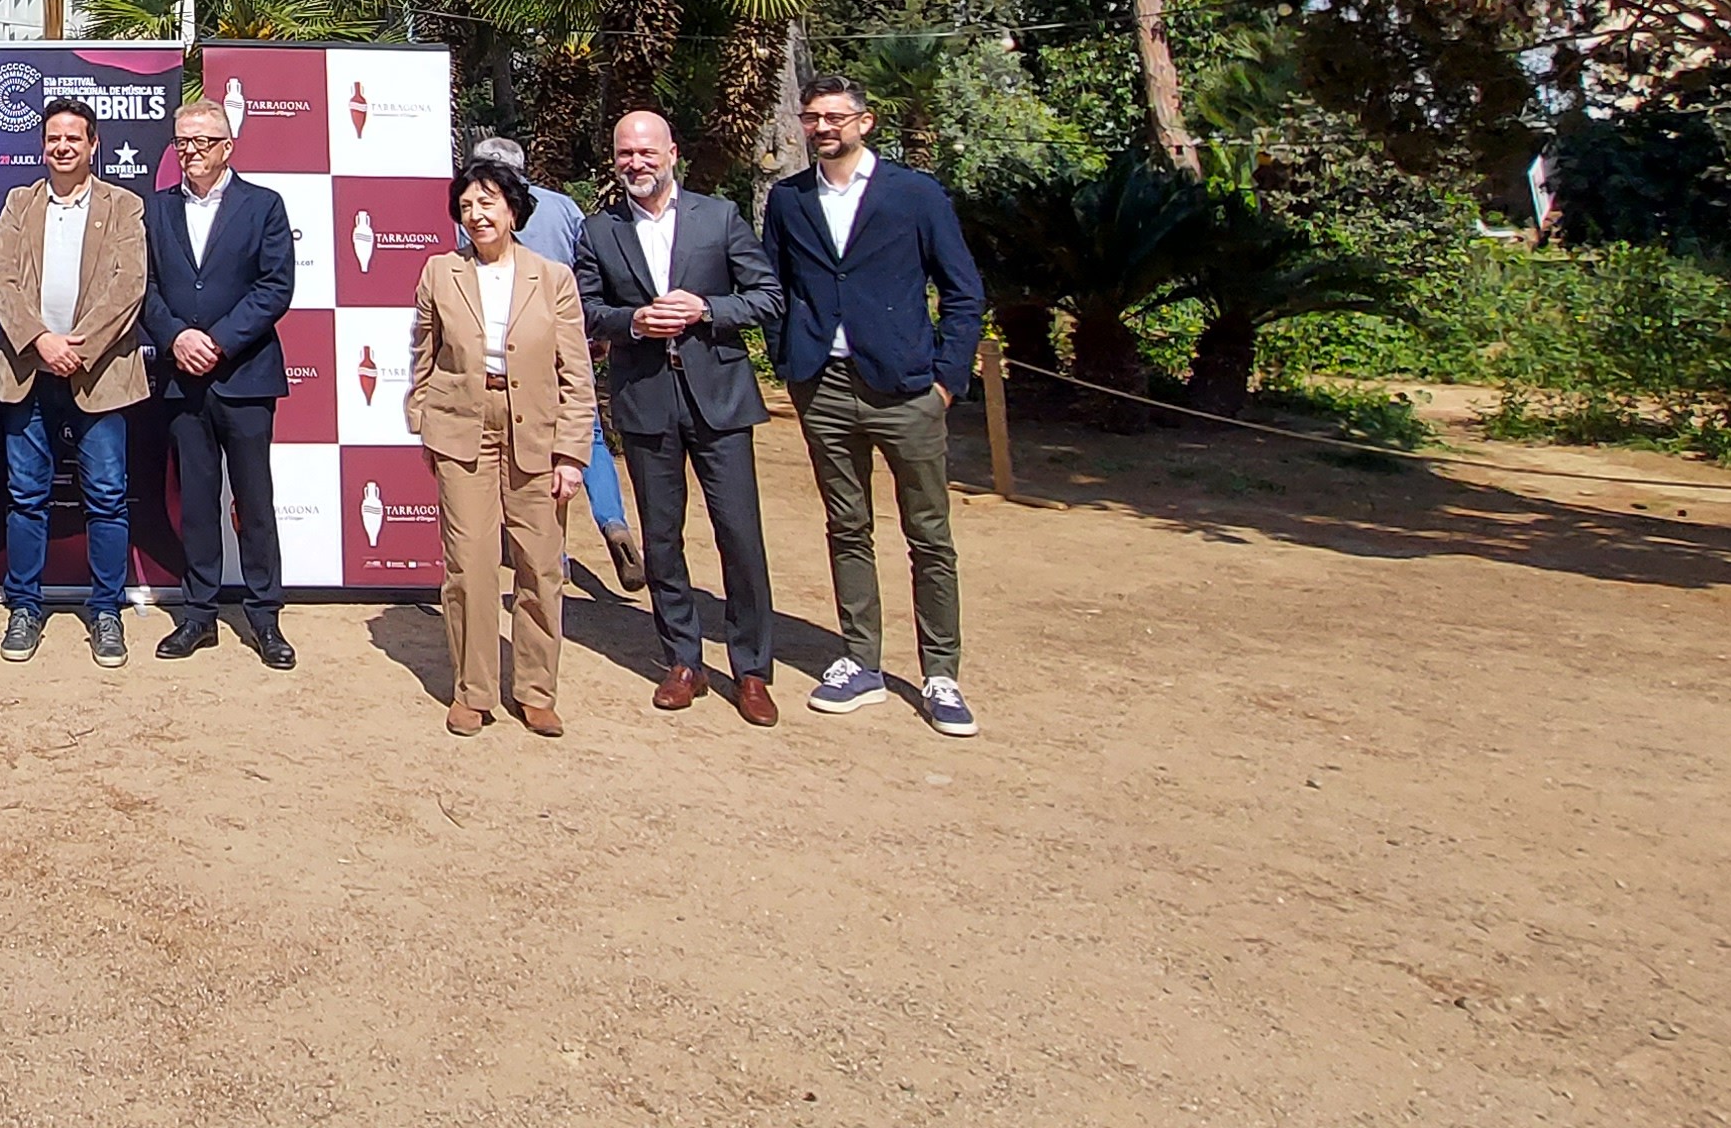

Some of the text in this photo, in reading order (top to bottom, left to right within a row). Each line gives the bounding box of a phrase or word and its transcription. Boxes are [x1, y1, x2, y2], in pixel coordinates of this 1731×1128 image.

[58, 77, 96, 86] FESTIVAL
[43, 84, 166, 95] INTERNACIONAL DE MÚSICA DE
[246, 100, 310, 111] TARRAGONA
[10, 155, 36, 165] JULIOL
[105, 164, 148, 175] ESTRELLA
[375, 233, 439, 244] TARRAGONA
[385, 505, 439, 515] TARRAGO
